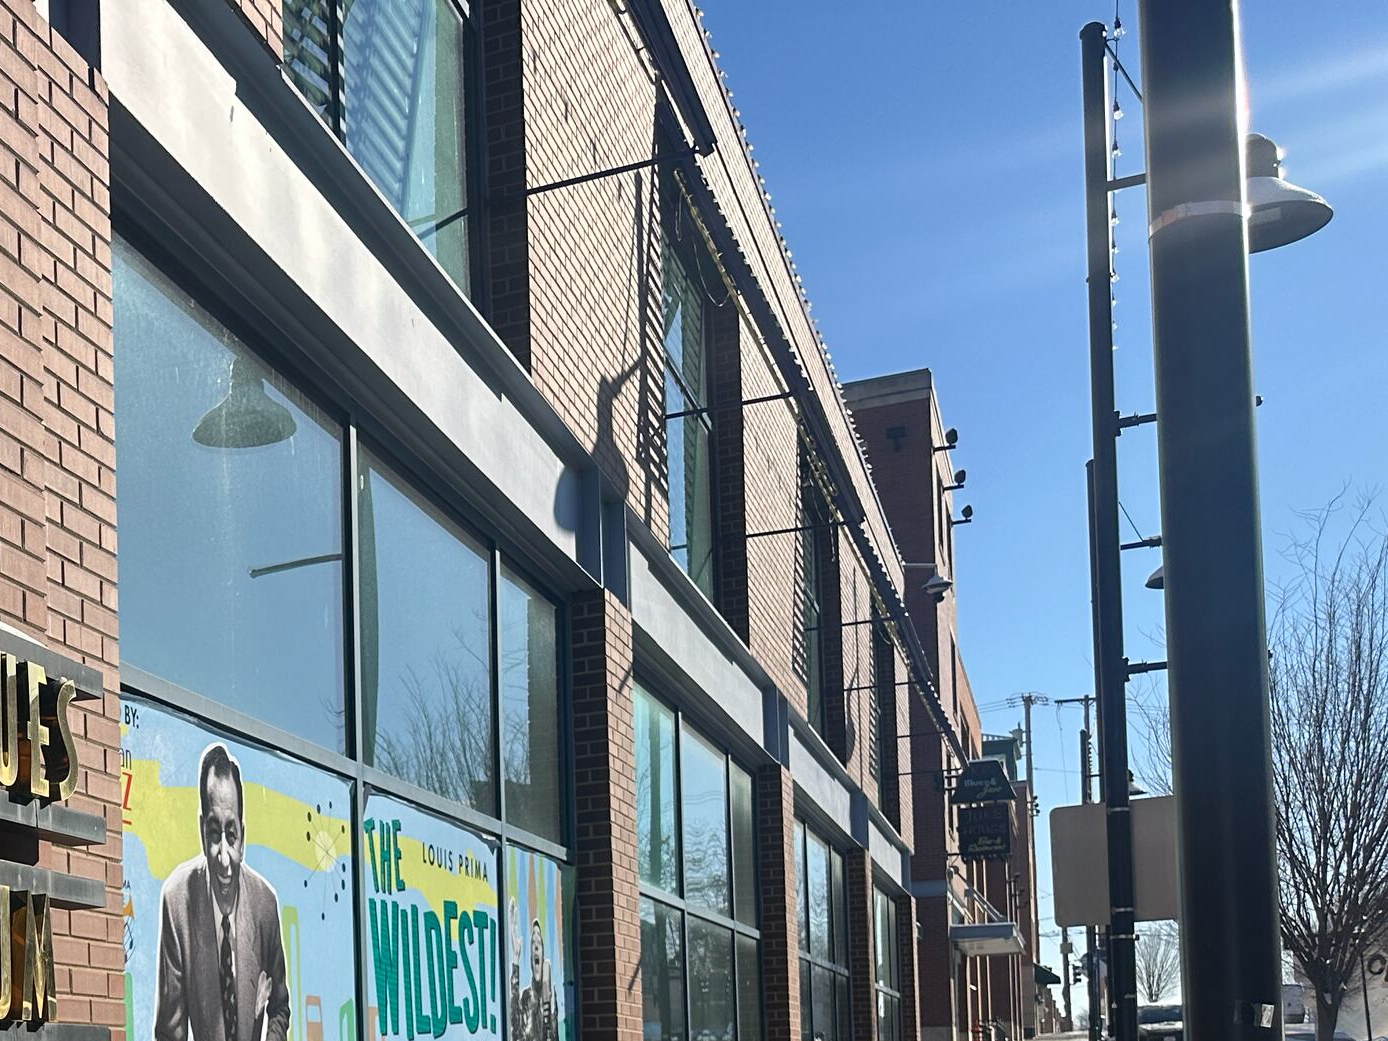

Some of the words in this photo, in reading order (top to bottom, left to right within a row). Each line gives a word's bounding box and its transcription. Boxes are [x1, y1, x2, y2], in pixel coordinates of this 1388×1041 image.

[124, 704, 139, 729] BY:
[364, 817, 405, 895] THE
[422, 842, 453, 872] LOUIS
[459, 854, 488, 882] PRIMA
[368, 898, 496, 1041] WILDEST!
